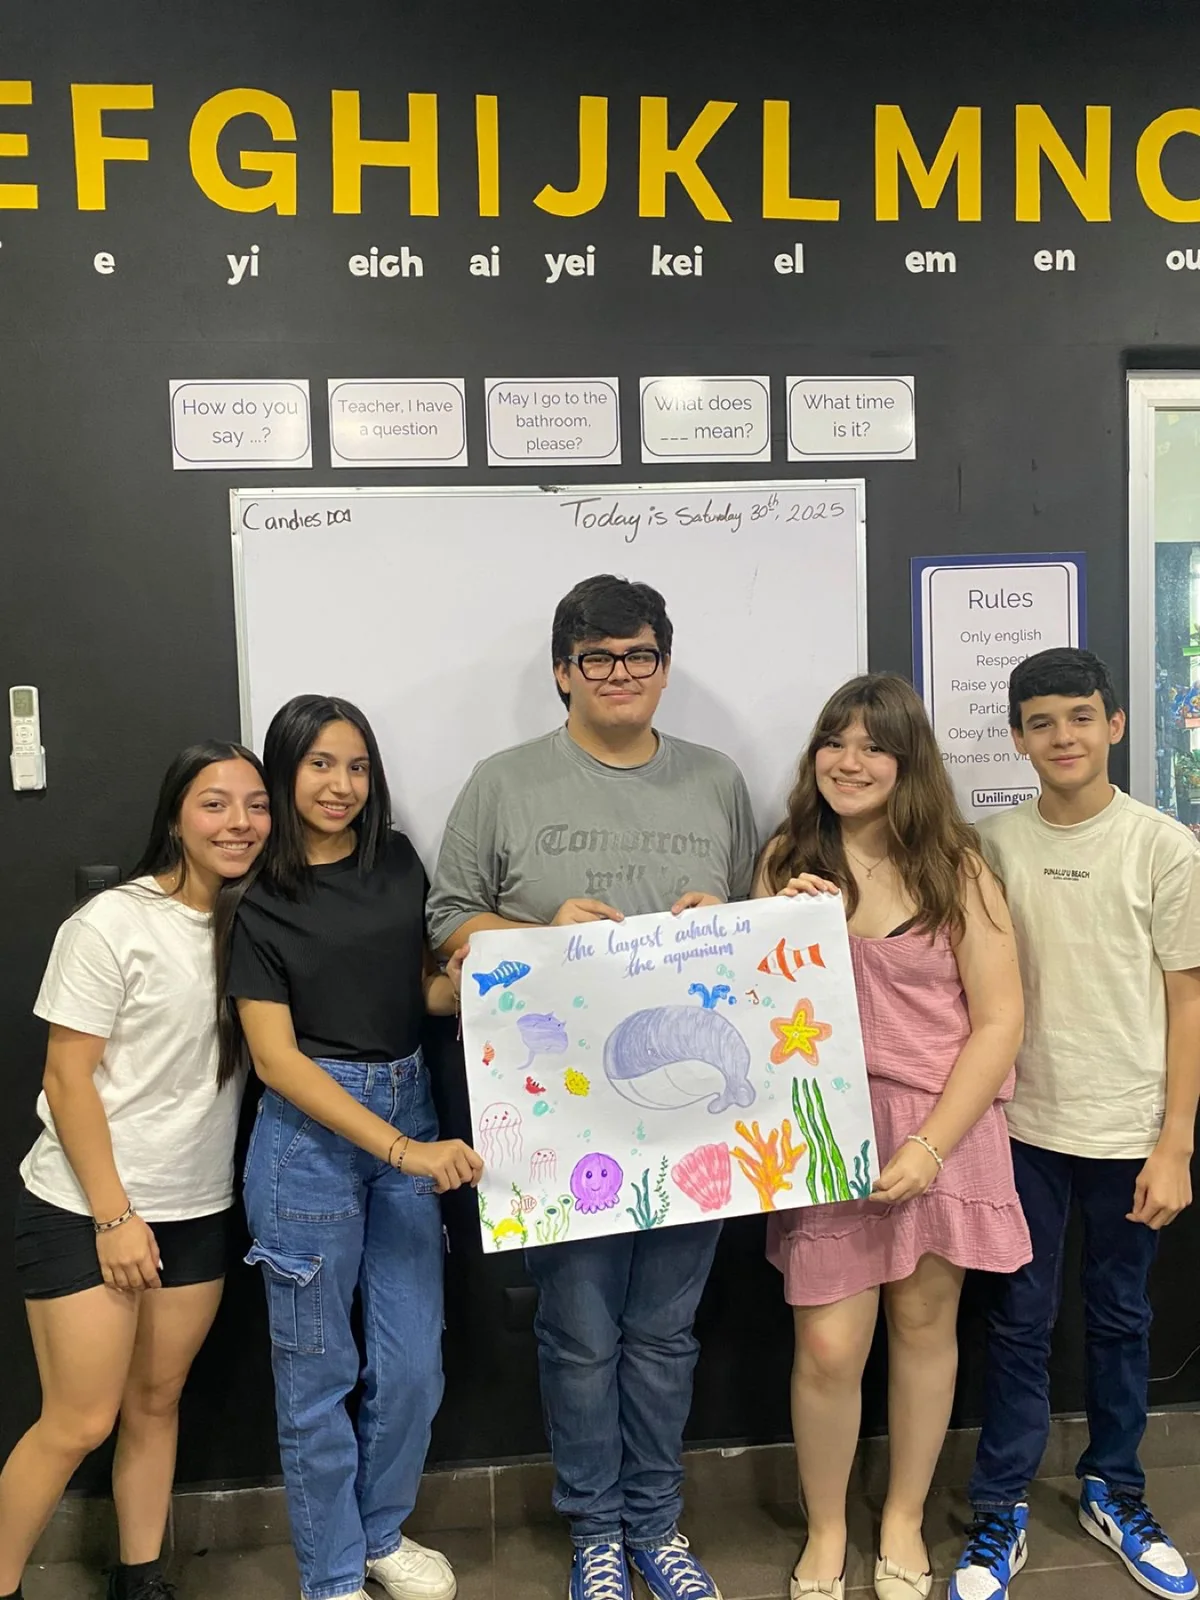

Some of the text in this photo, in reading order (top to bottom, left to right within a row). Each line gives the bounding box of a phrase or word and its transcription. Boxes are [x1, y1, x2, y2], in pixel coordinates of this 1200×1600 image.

[71, 84, 154, 211] F
[189, 88, 297, 215] G
[332, 90, 439, 216] H
[476, 95, 499, 217] I
[534, 96, 608, 217] J
[639, 96, 736, 222] K
[763, 100, 839, 221] L
[875, 105, 981, 221] M
[1016, 105, 1111, 222] N
[93, 251, 116, 275] e
[227, 244, 260, 286] yi
[348, 247, 424, 278] eich
[469, 245, 500, 277] ai
[545, 245, 596, 284] yei
[651, 244, 703, 277] kei
[774, 243, 804, 275] el
[905, 251, 957, 274] em
[1033, 249, 1076, 272] en
[182, 397, 299, 419] How do you
[337, 399, 454, 415] Teacher, I have
[498, 391, 608, 408] May I go to the
[654, 395, 753, 412] What does
[802, 393, 896, 410] What time
[212, 428, 245, 448] say
[359, 422, 438, 439] a question
[694, 422, 754, 440] mean?
[832, 421, 871, 438] is it?
[526, 436, 584, 454] please?
[242, 502, 322, 531] Candies
[560, 497, 642, 544] Today
[647, 505, 669, 527] is
[674, 498, 743, 533] Saturday
[785, 502, 845, 522] 2025
[968, 587, 1034, 610] Rules
[960, 628, 1042, 645] Only english
[951, 679, 987, 692] Raise
[948, 727, 1009, 742] Obey the
[941, 751, 990, 764] Phones
[993, 751, 1010, 763] on
[976, 791, 1034, 806] Unilingua
[535, 823, 713, 858] Tomorrow
[1071, 869, 1090, 879] BEACH
[561, 934, 596, 966] the
[604, 925, 665, 963] largest
[734, 916, 755, 936] in
[623, 942, 737, 980] the aquarium
